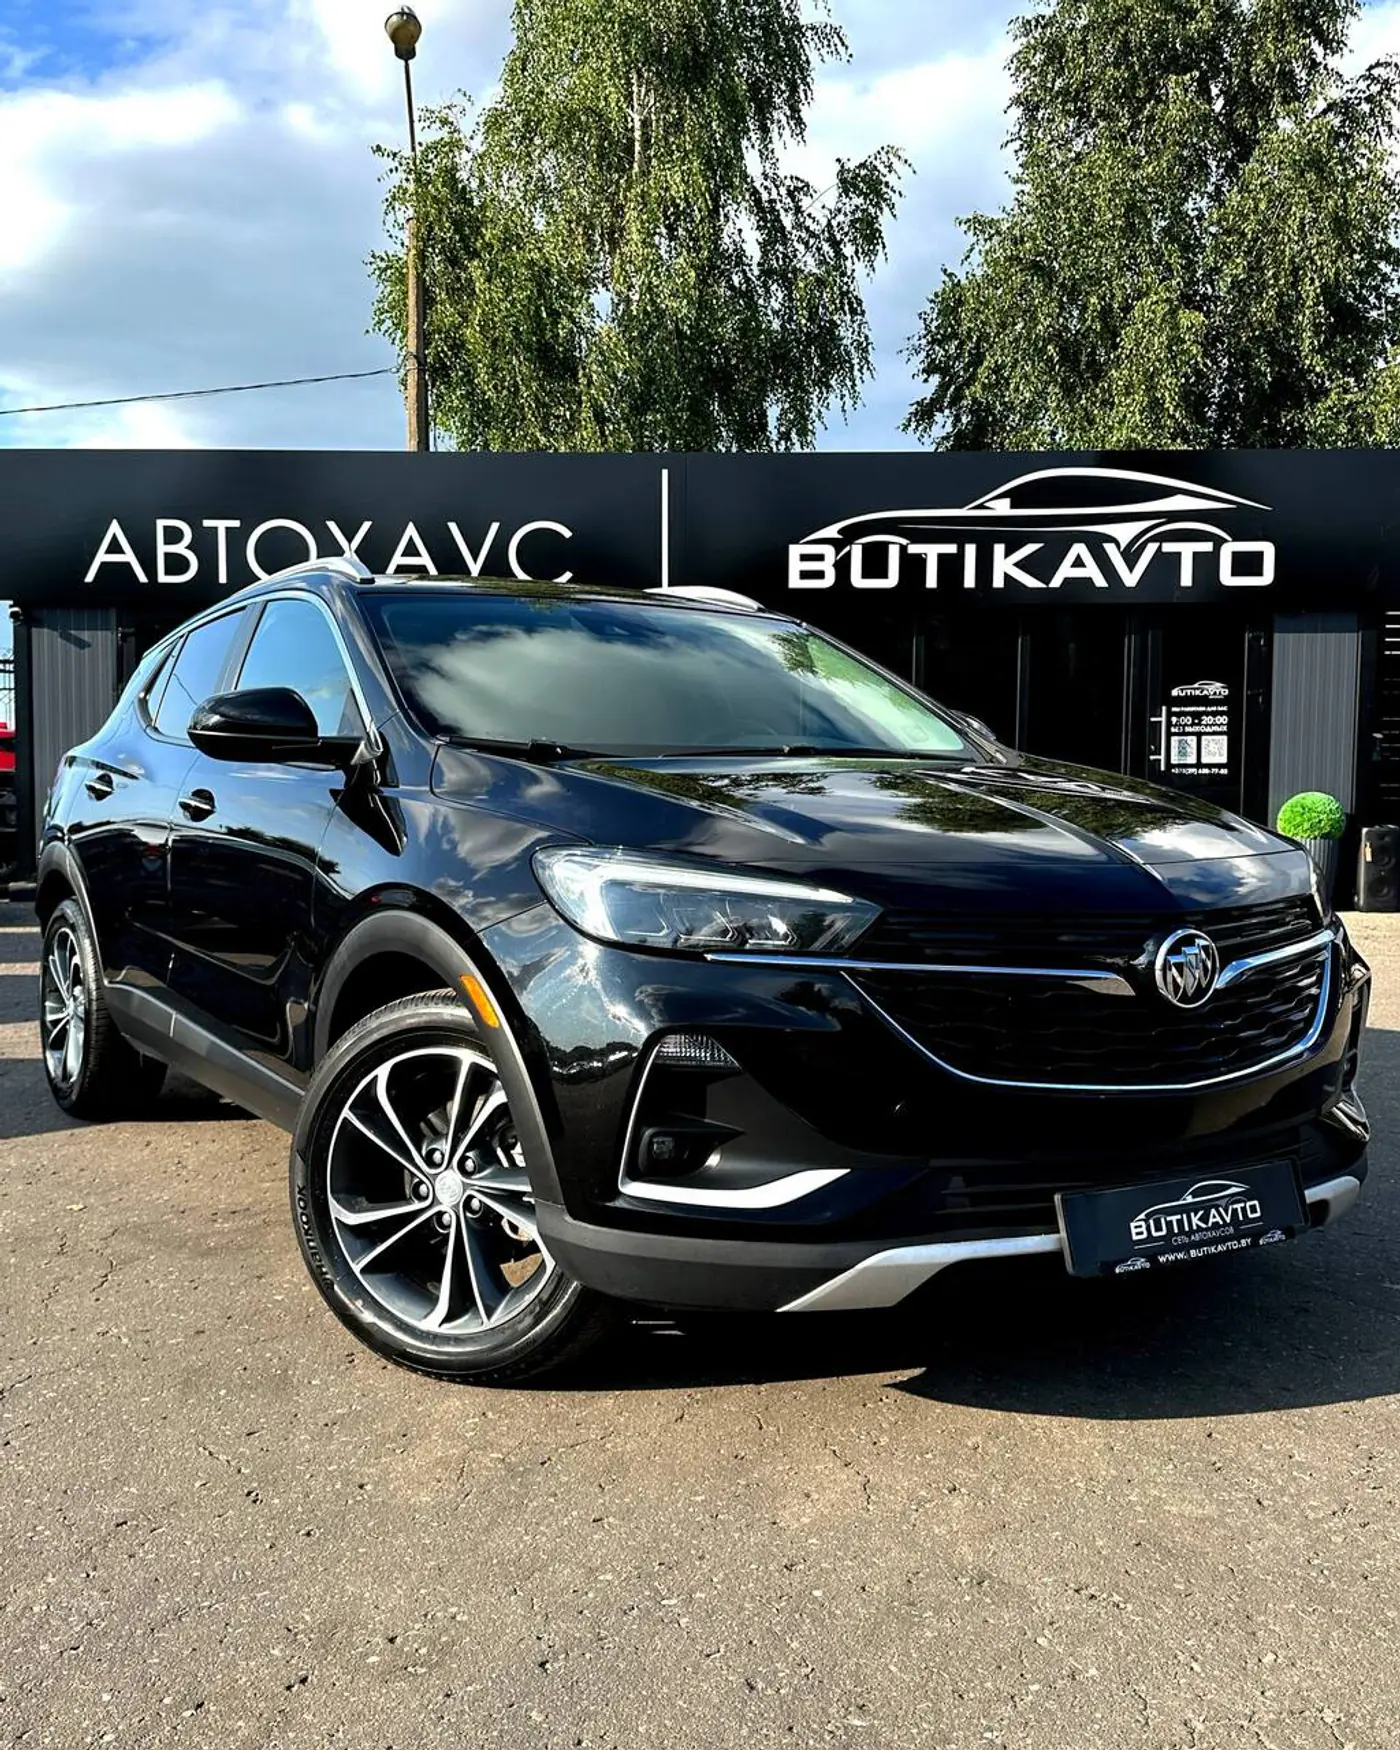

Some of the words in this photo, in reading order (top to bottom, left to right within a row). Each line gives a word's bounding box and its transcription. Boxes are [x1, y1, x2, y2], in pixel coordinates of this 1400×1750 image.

[787, 540, 1277, 590] BUTIKAVTO
[1171, 689, 1229, 697] BUTIKAVTO
[1171, 716, 1192, 725] 9:00
[1200, 715, 1228, 725] 20:00
[1130, 1200, 1262, 1241] BUTIKAVTO
[1171, 1235, 1189, 1246] СЕТЬ
[1190, 1226, 1235, 1243] АВТОХАУСОВ
[1189, 1237, 1252, 1258] BUTIKAVTO.BY
